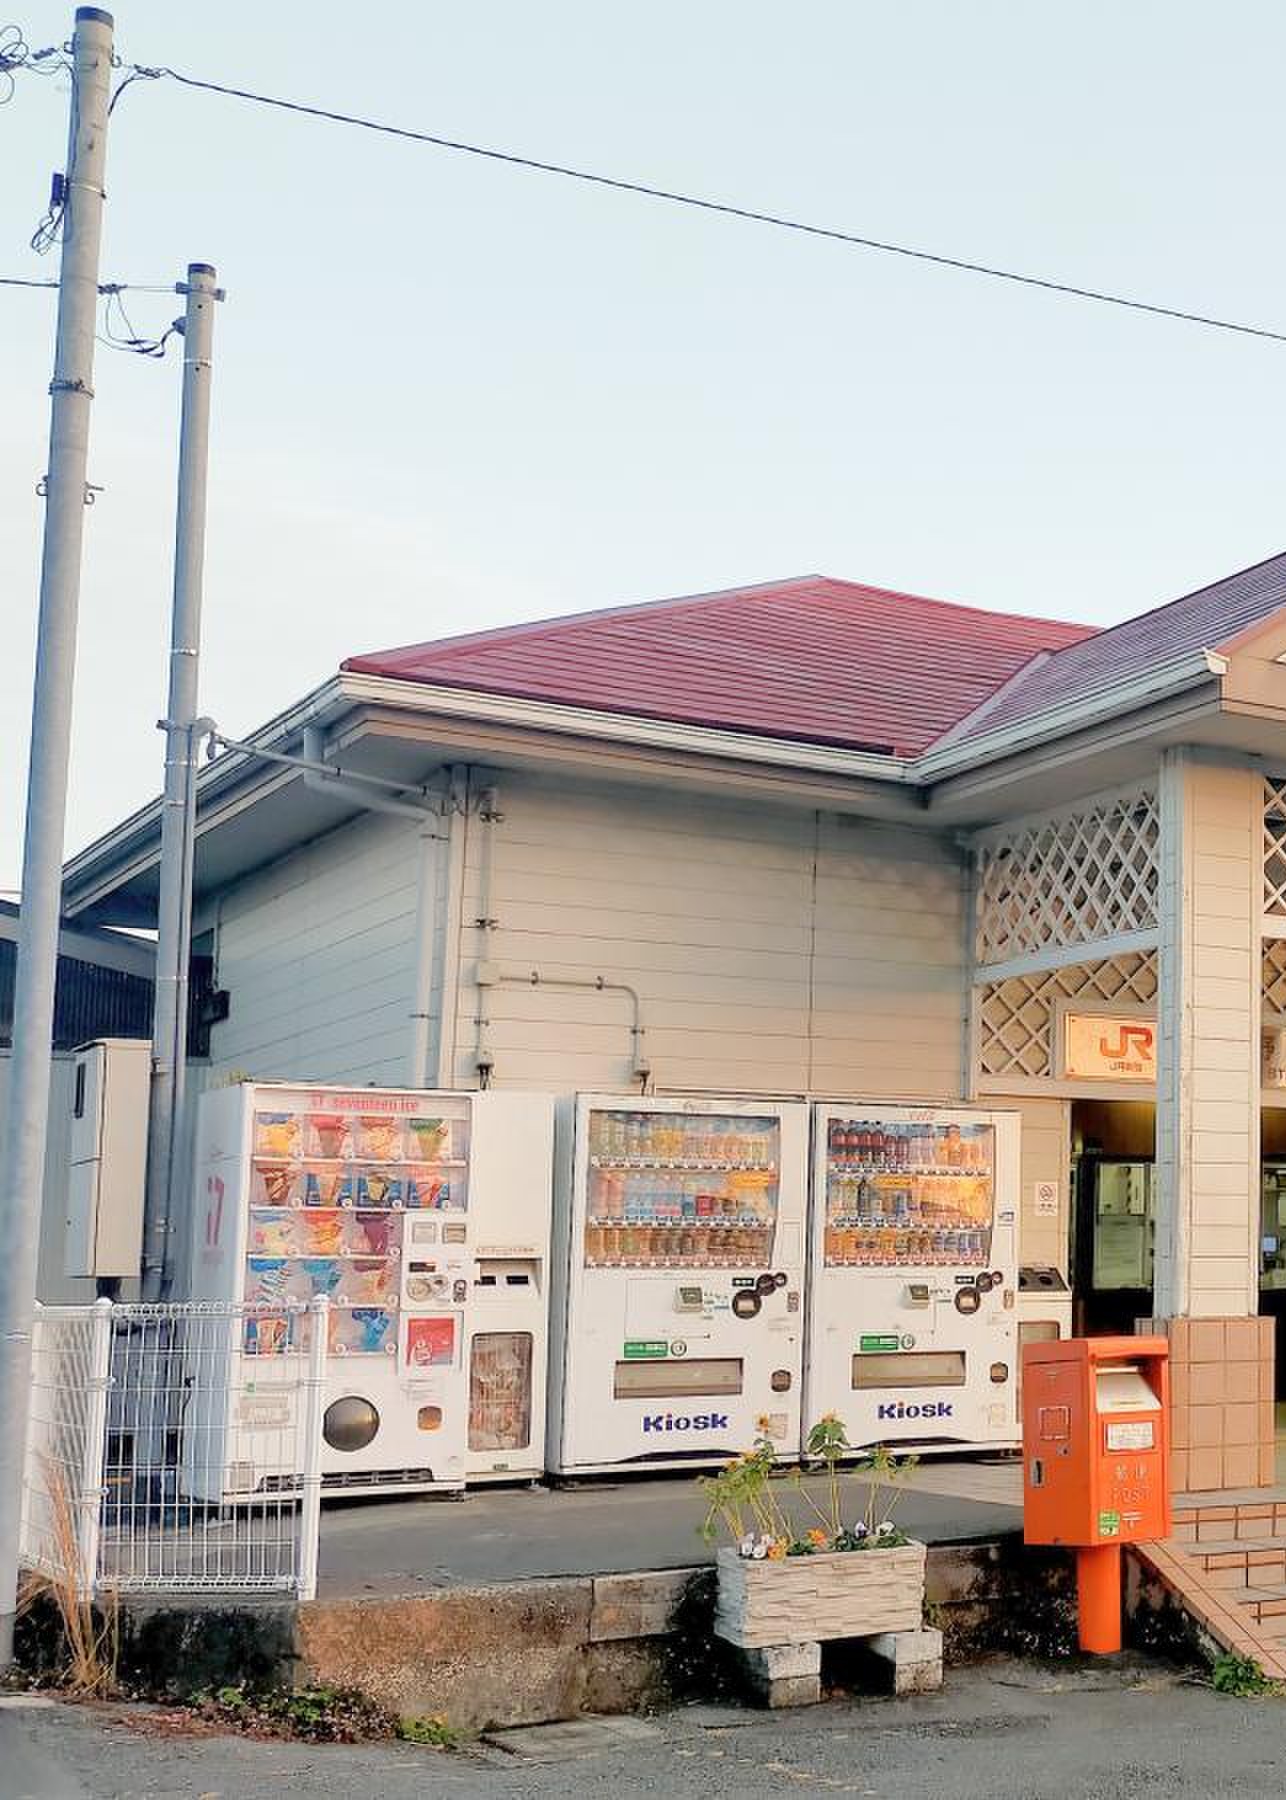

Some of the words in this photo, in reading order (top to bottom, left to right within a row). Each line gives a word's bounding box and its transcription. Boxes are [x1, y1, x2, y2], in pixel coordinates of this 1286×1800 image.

[1100, 1025, 1153, 1060] JR
[878, 1401, 953, 1419] Kiosk
[643, 1413, 728, 1432] Kiosk
